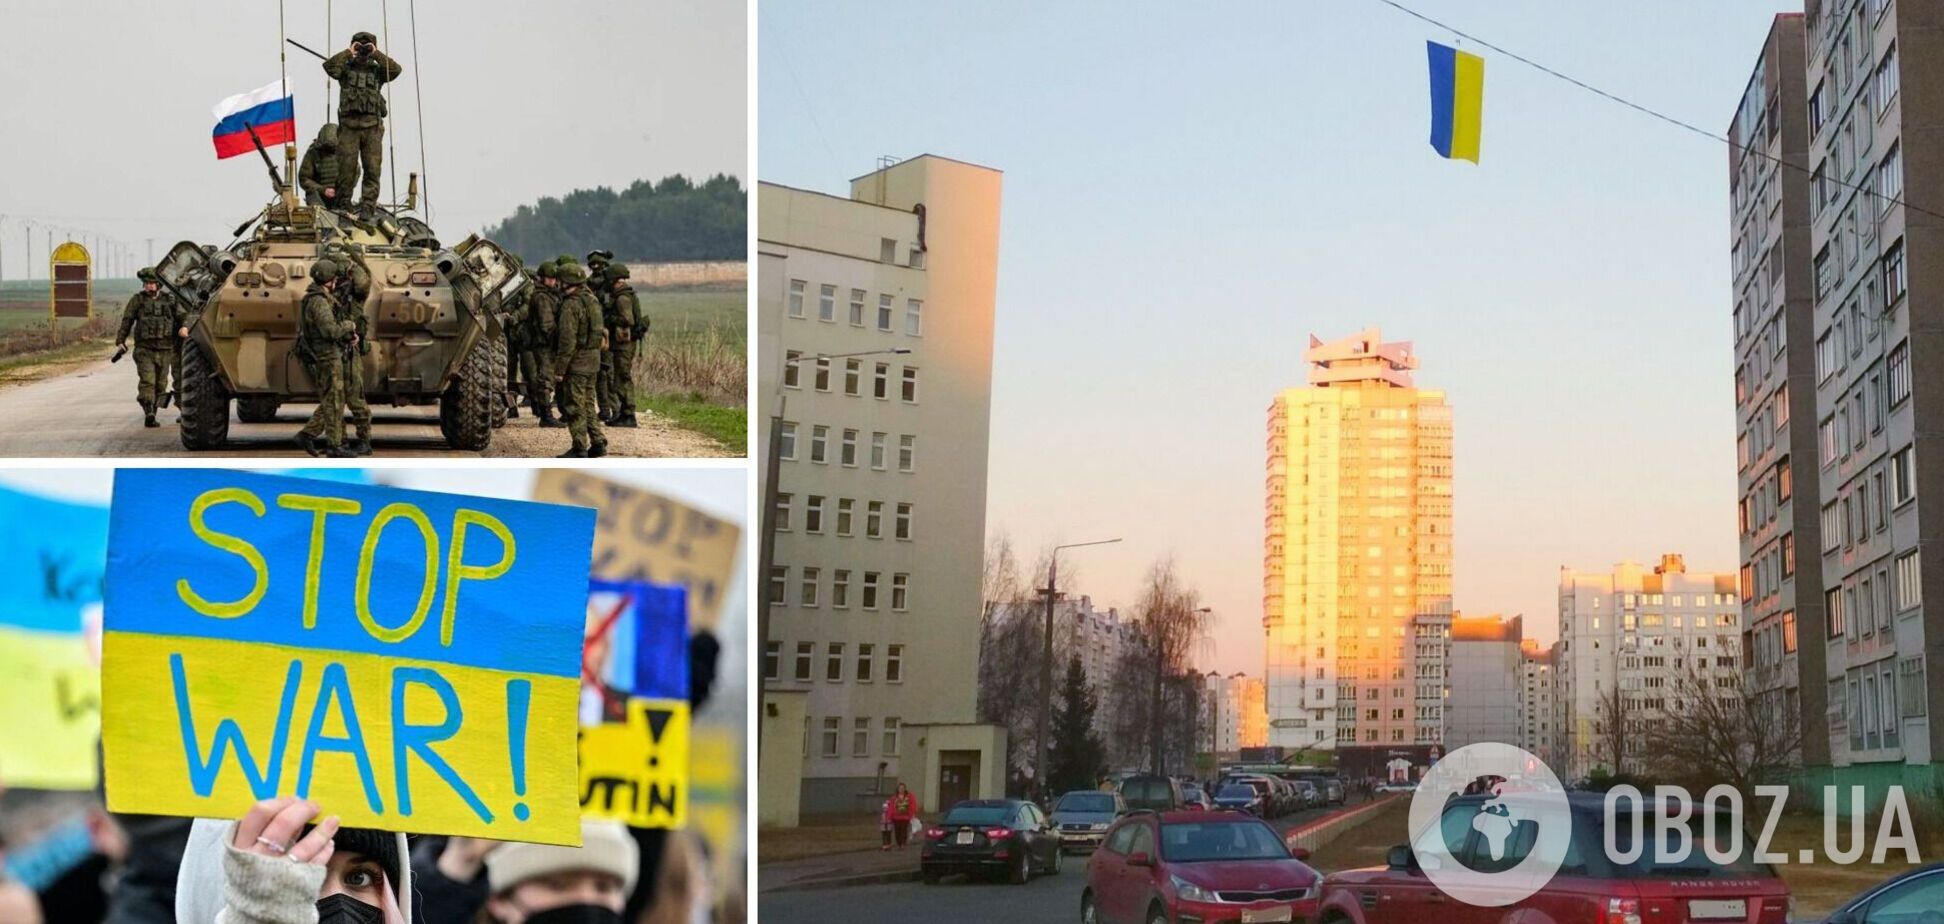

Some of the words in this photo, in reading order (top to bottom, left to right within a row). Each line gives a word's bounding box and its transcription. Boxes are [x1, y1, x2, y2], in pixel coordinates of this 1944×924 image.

[399, 302, 441, 324] 507
[176, 487, 517, 647] STOP
[169, 652, 532, 824] WAR!
